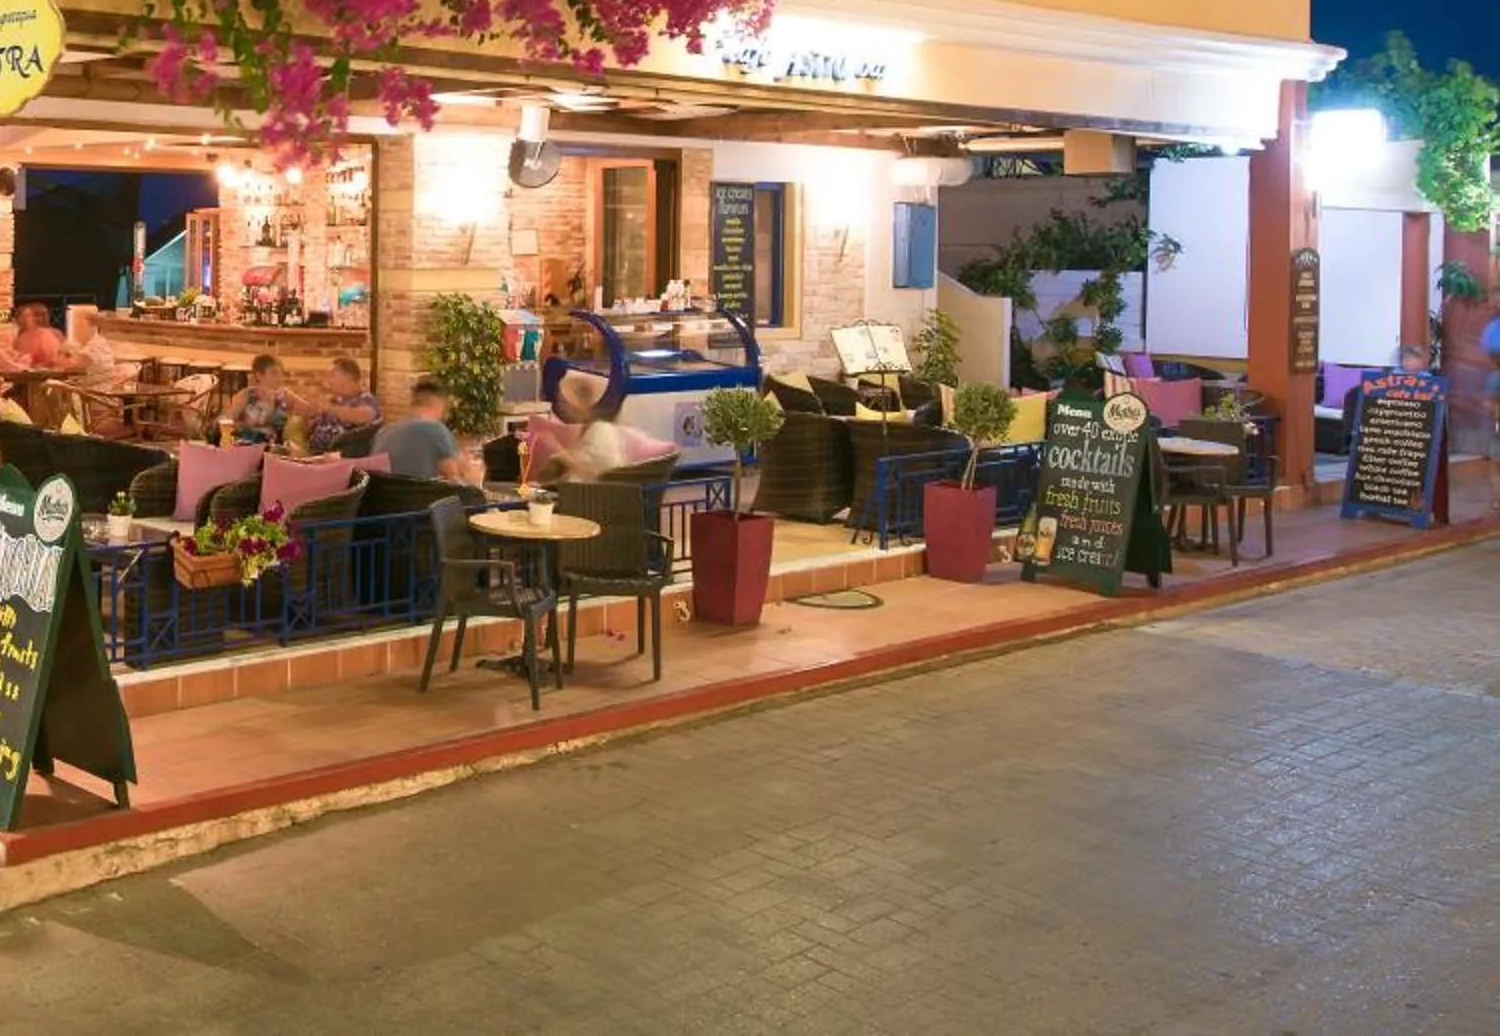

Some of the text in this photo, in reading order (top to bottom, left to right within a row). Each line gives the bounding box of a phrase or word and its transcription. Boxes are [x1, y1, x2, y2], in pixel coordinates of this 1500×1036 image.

[1057, 404, 1092, 419] Menu
[1053, 423, 1077, 437] over
[1081, 421, 1099, 440] 40
[1050, 433, 1135, 478] cocktails
[1046, 485, 1122, 515] fresh fruits
[1072, 535, 1105, 548] and
[1056, 547, 1075, 561] ice
